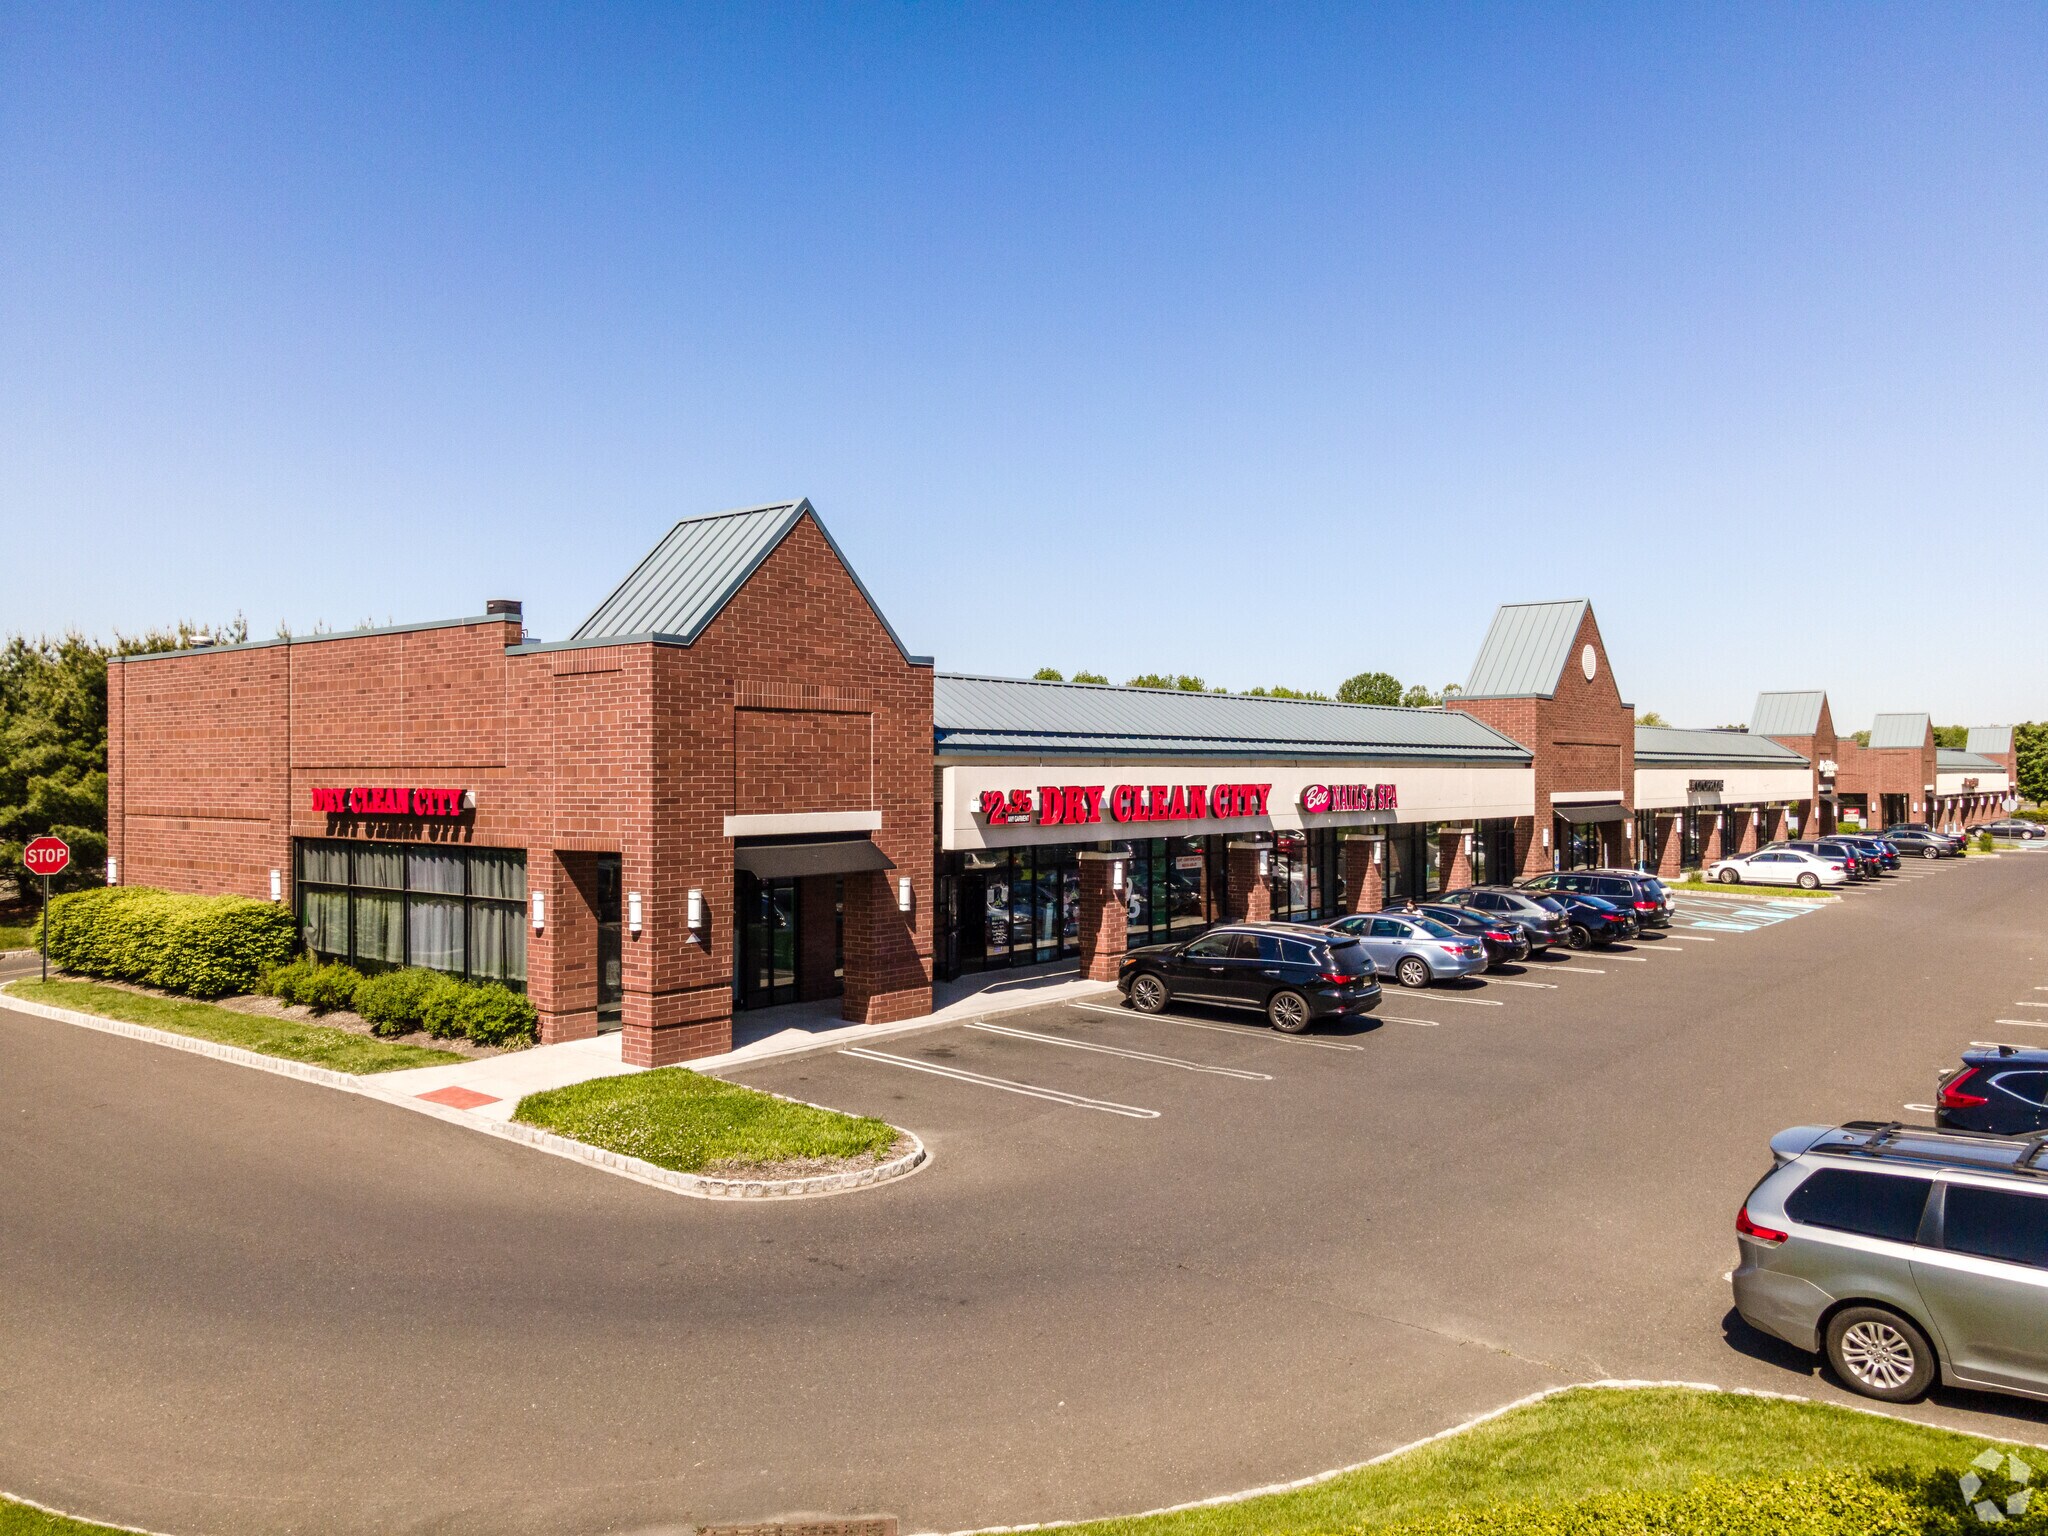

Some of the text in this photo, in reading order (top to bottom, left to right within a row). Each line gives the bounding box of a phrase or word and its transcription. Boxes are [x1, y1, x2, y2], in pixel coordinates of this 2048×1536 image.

[311, 787, 462, 816] DRY CLEAN CITY
[982, 783, 1272, 825] $2.95 DRY CLEAN CITY
[1306, 785, 1329, 809] Bee
[1331, 784, 1368, 811] NAILS
[1377, 783, 1398, 810] SPA
[27, 848, 67, 864] STOP
